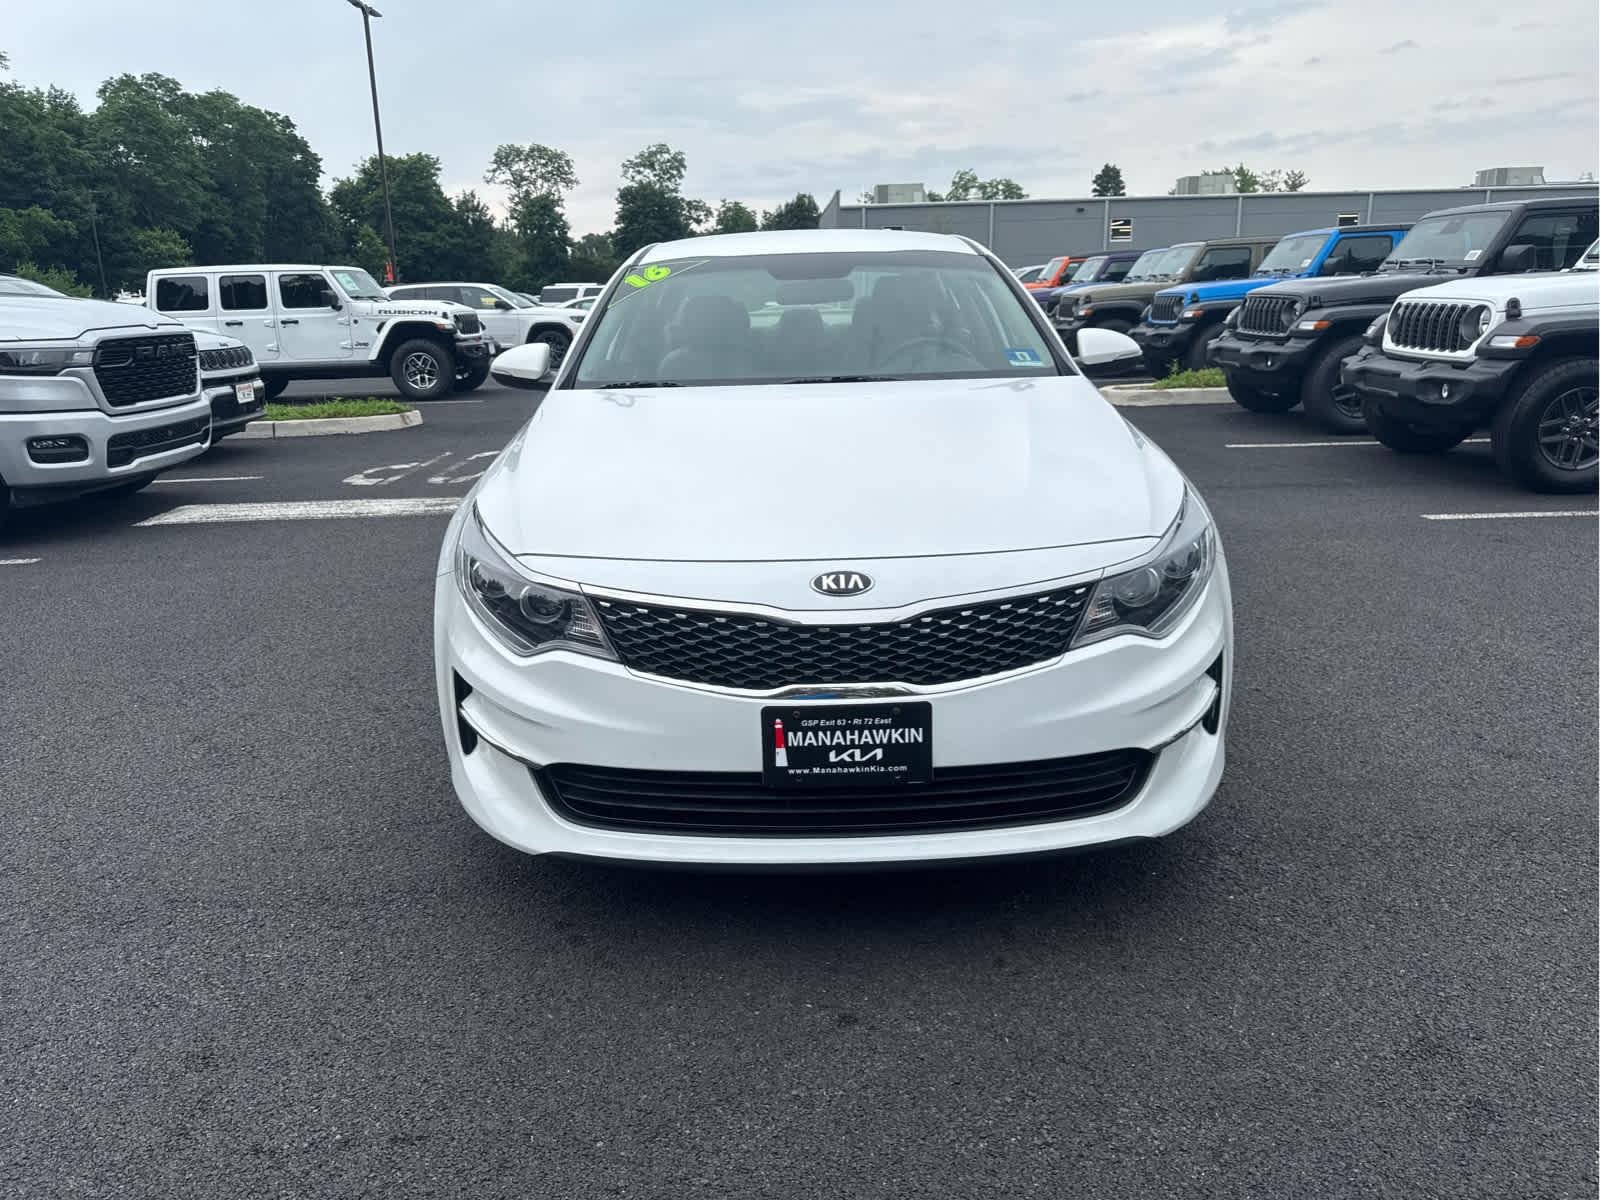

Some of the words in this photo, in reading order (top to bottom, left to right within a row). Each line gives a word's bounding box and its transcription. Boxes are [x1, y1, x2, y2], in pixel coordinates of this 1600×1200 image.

[624, 265, 671, 288] 16
[821, 574, 865, 590] KIA
[801, 719, 819, 727] GSP
[820, 719, 836, 727] Exit
[836, 718, 846, 726] 63
[853, 717, 862, 725] Rt
[863, 717, 874, 725] 72
[874, 717, 892, 725] East
[787, 727, 923, 747] MANAHAWKIN
[788, 765, 908, 775] www.ManahawkinKia.com
